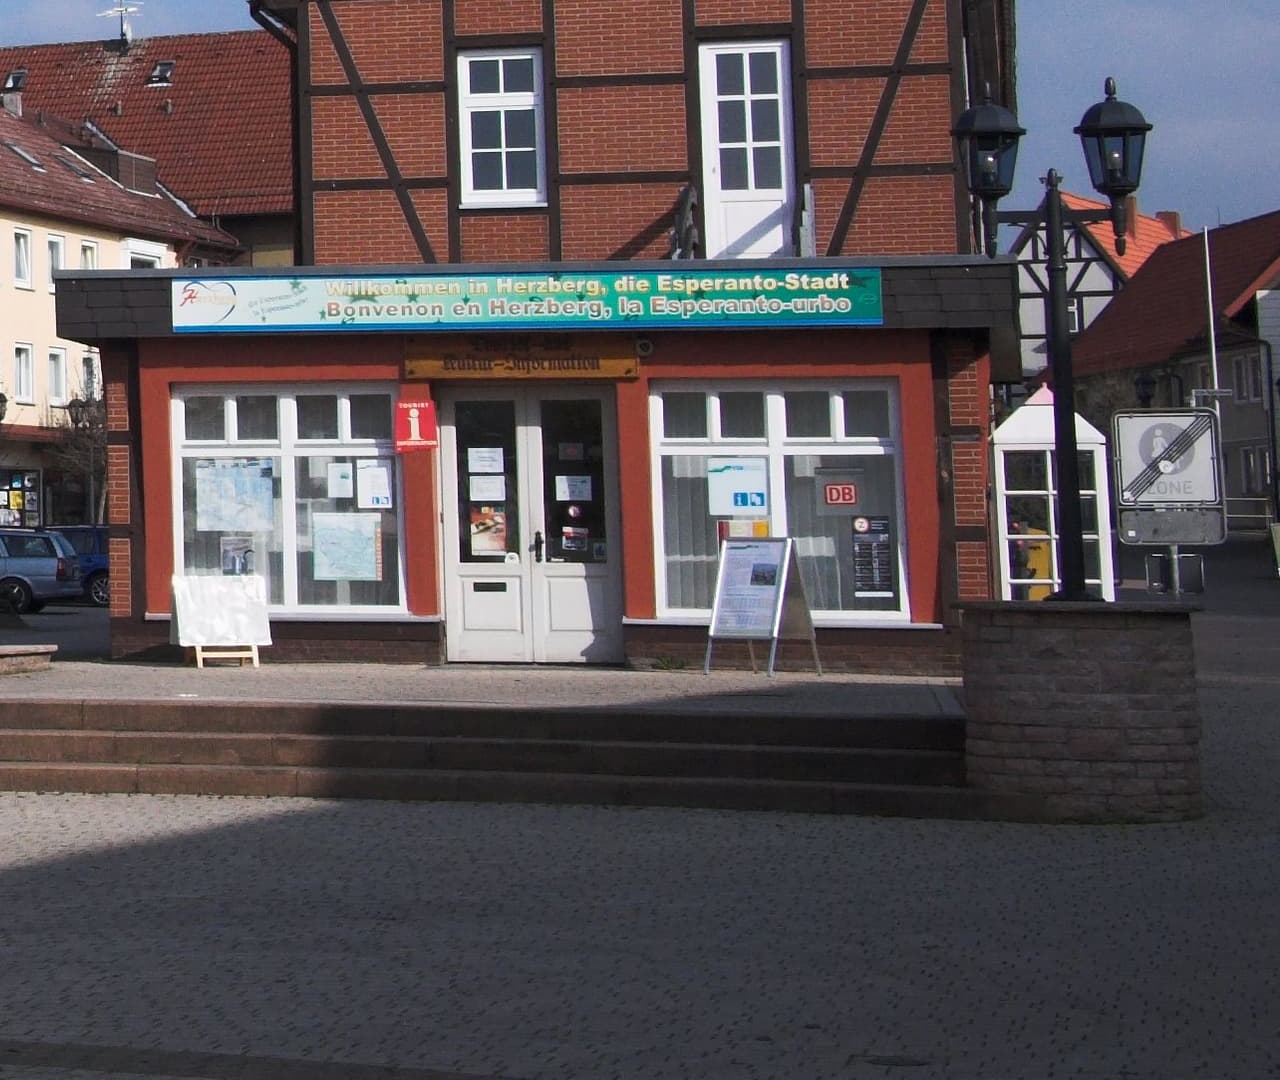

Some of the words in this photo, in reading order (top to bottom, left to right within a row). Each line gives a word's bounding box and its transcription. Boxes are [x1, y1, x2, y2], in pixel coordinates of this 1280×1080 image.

[325, 278, 462, 296] Willkommen
[468, 277, 488, 294] in
[497, 275, 607, 296] Herzberg,
[614, 275, 649, 292] die
[657, 272, 850, 296] Esperanto-Stadt
[326, 300, 445, 318] Bonvenon
[452, 302, 481, 317] en
[489, 296, 612, 320] Herzberg,
[619, 296, 643, 316] la
[650, 293, 852, 318] Esperanto-urbo
[828, 486, 854, 502] DB
[1147, 480, 1193, 495] ZONE
